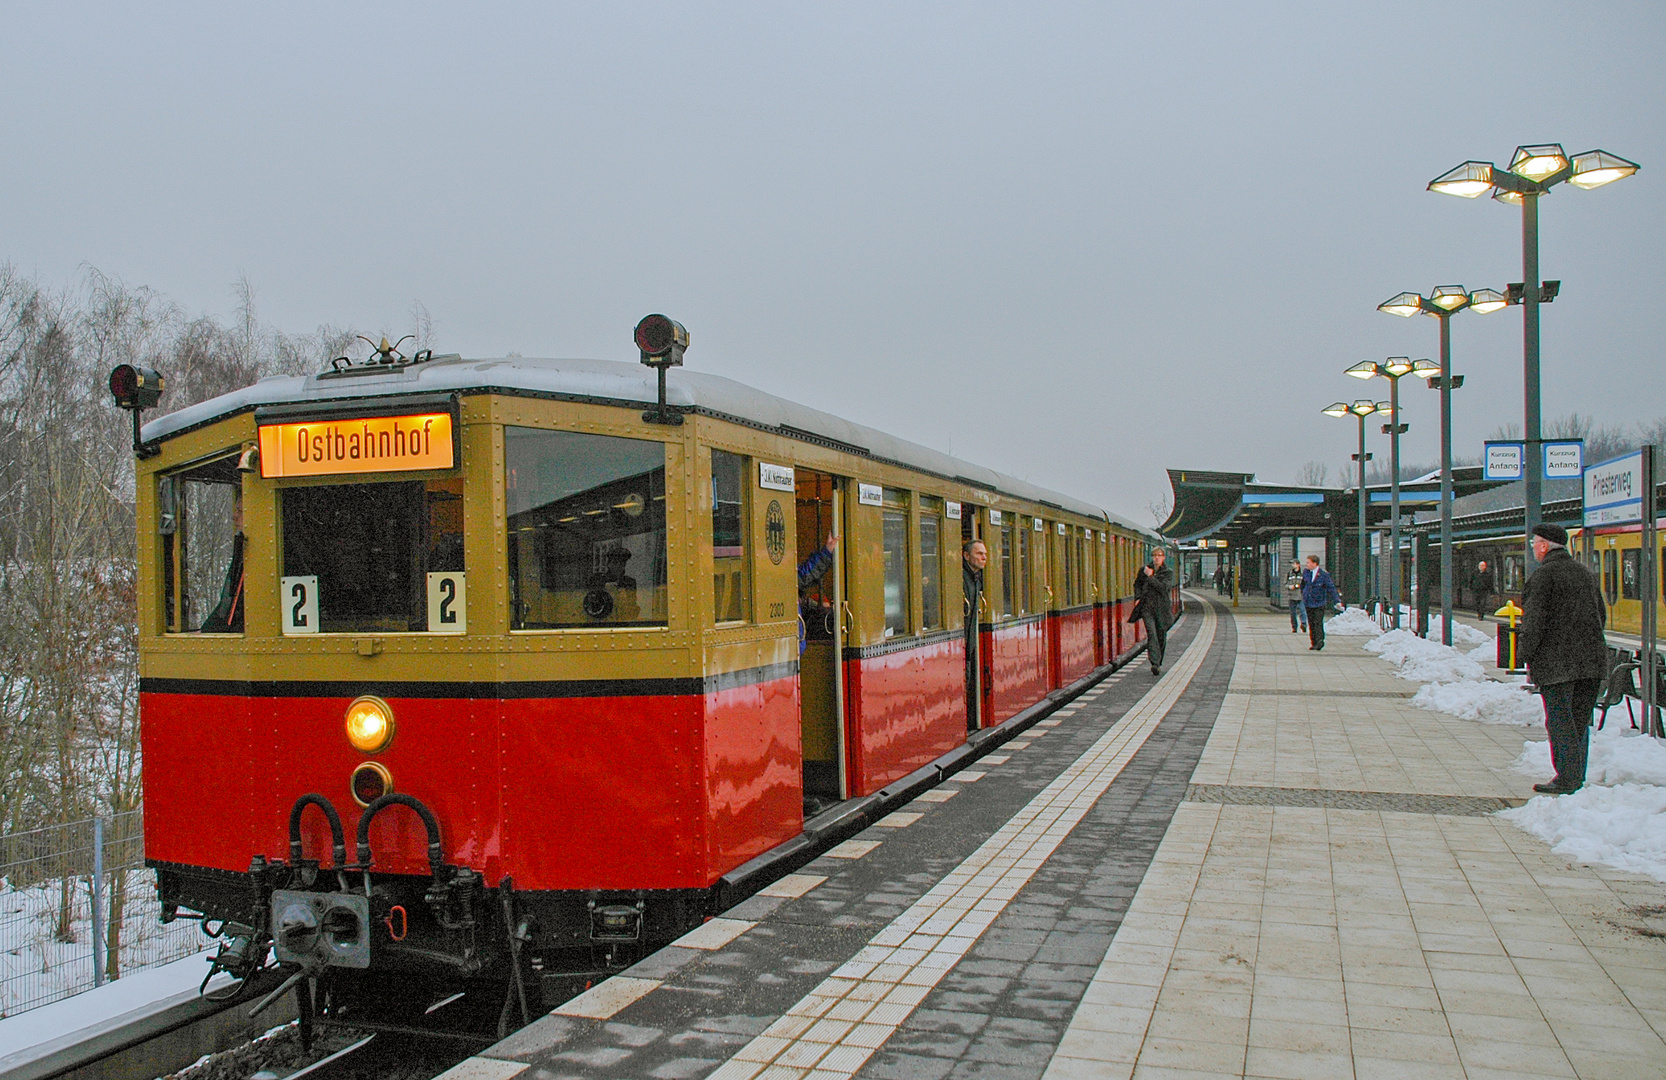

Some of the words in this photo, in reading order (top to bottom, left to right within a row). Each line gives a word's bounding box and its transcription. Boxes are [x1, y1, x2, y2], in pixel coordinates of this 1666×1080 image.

[298, 419, 433, 463] Ostbahnhof
[1489, 462, 1519, 471] Anfang
[1490, 451, 1517, 459] Kurzzug
[1548, 461, 1579, 470] Anfang
[1593, 470, 1632, 497] Priesterweg
[291, 583, 307, 627] 2
[439, 577, 456, 624] 2
